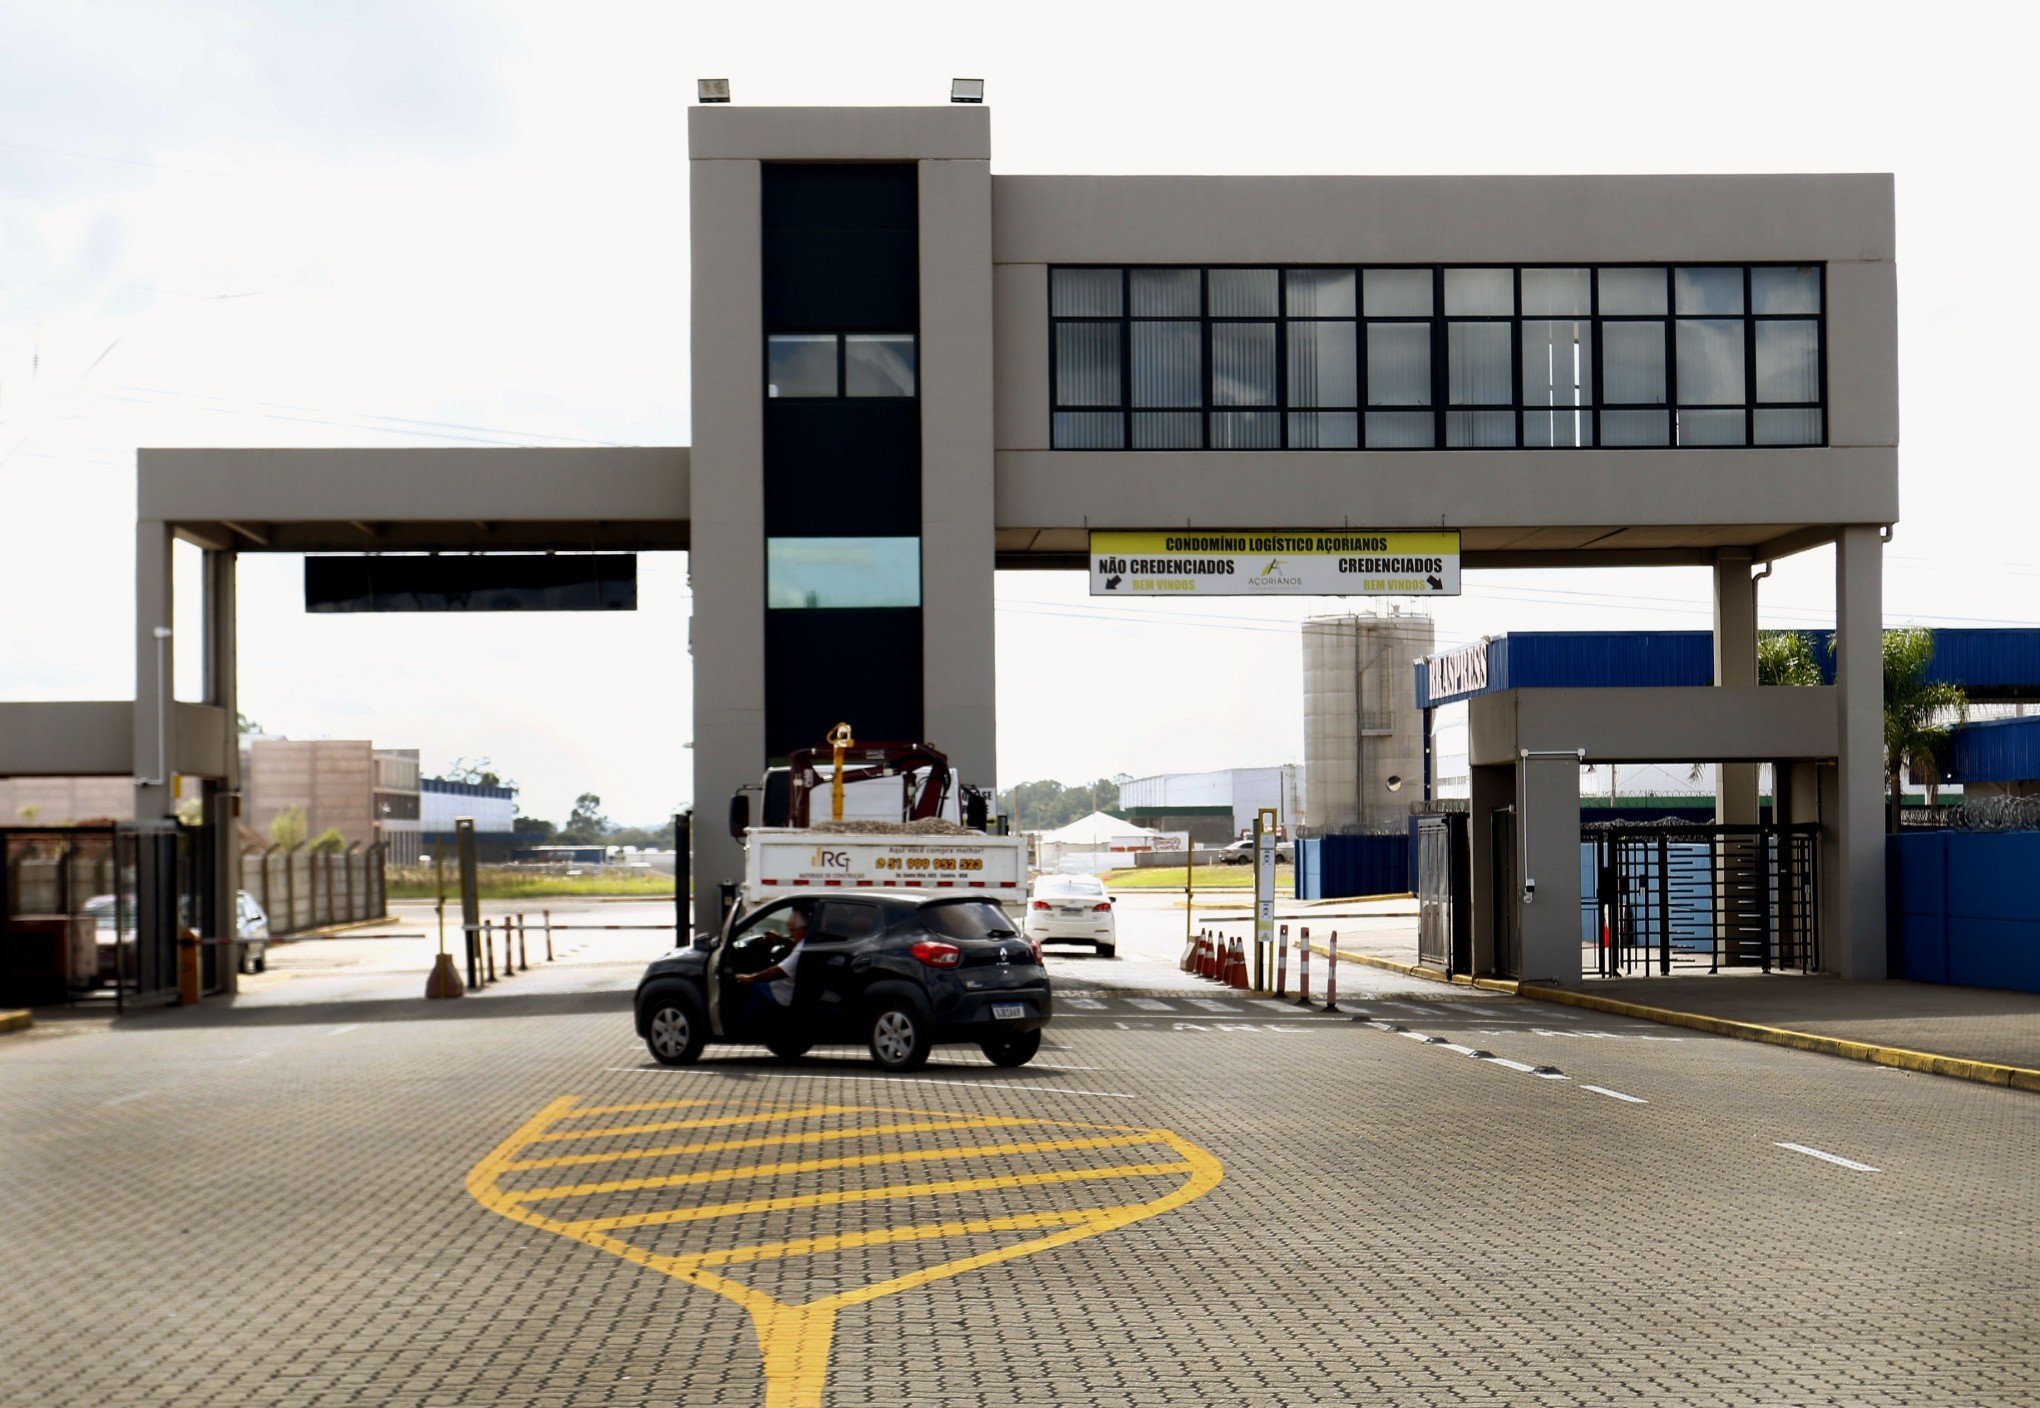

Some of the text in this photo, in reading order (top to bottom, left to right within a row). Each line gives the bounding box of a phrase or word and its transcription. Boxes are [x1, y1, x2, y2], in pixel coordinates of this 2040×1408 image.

[1165, 536, 1387, 553] CONDOMÍNIO LOGÍSTICO AÇORIANOS
[1099, 557, 1234, 574] NÃO CREDENCIADOS
[1339, 558, 1442, 573] CREDENCIADOS
[1133, 579, 1195, 590] BEM VINDOS
[1248, 577, 1302, 586] AÇORIANOS
[1364, 579, 1425, 590] BEM VINDOS
[1428, 643, 1487, 700] BRASPRESS
